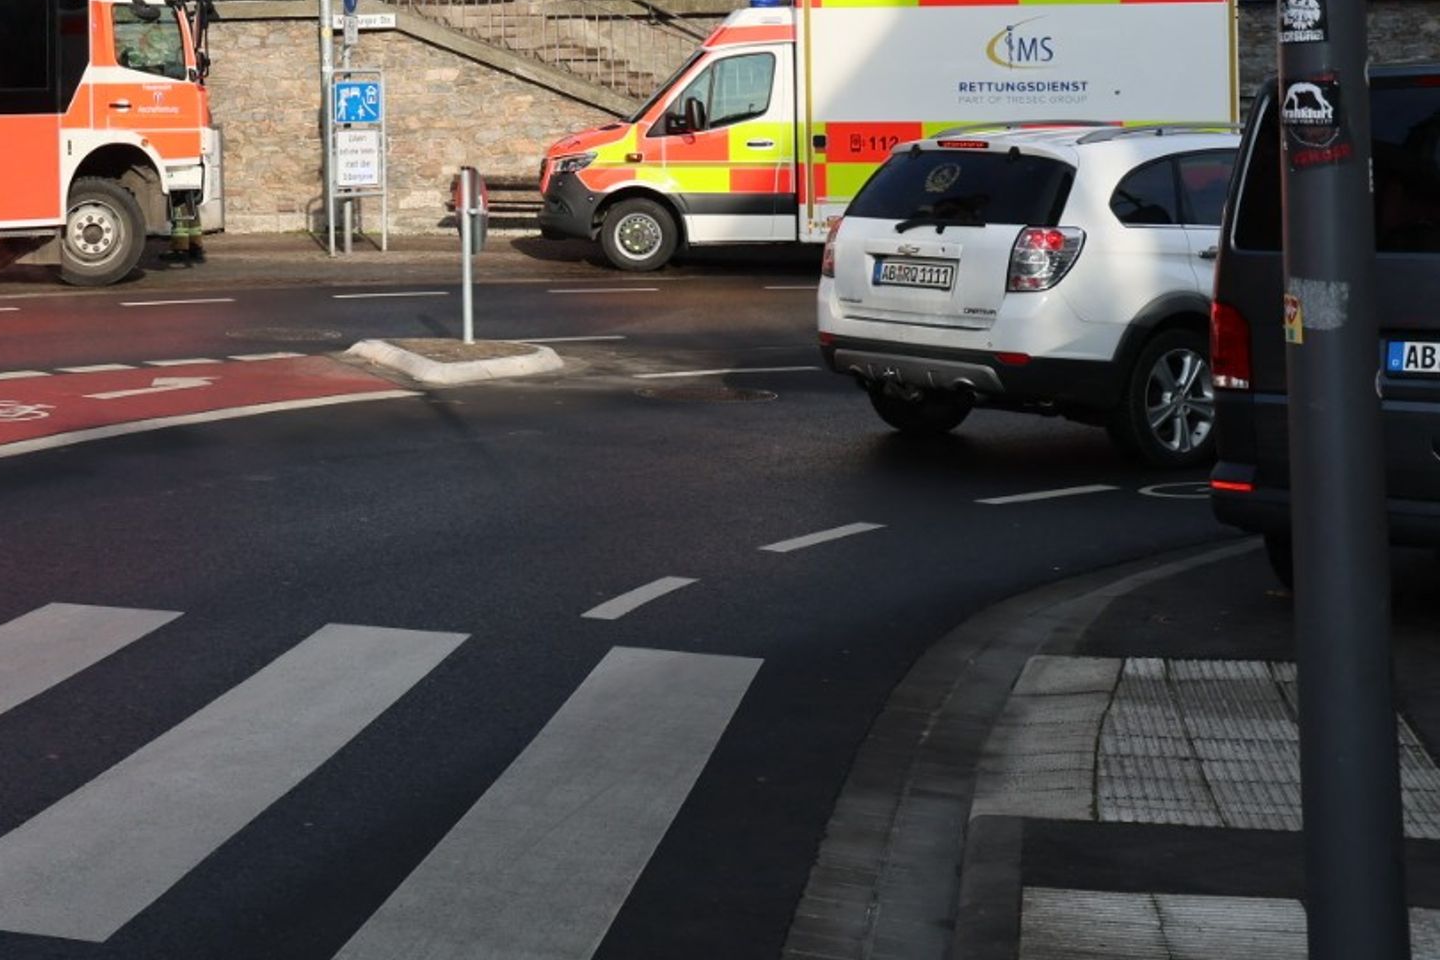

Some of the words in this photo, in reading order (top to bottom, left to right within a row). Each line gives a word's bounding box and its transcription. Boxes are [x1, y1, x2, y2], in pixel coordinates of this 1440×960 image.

[959, 81, 1088, 93] RETTUNGSDIENST
[869, 136, 899, 151] 112
[882, 265, 896, 281] AB
[919, 268, 949, 285] 1111
[1405, 345, 1436, 369] AB
